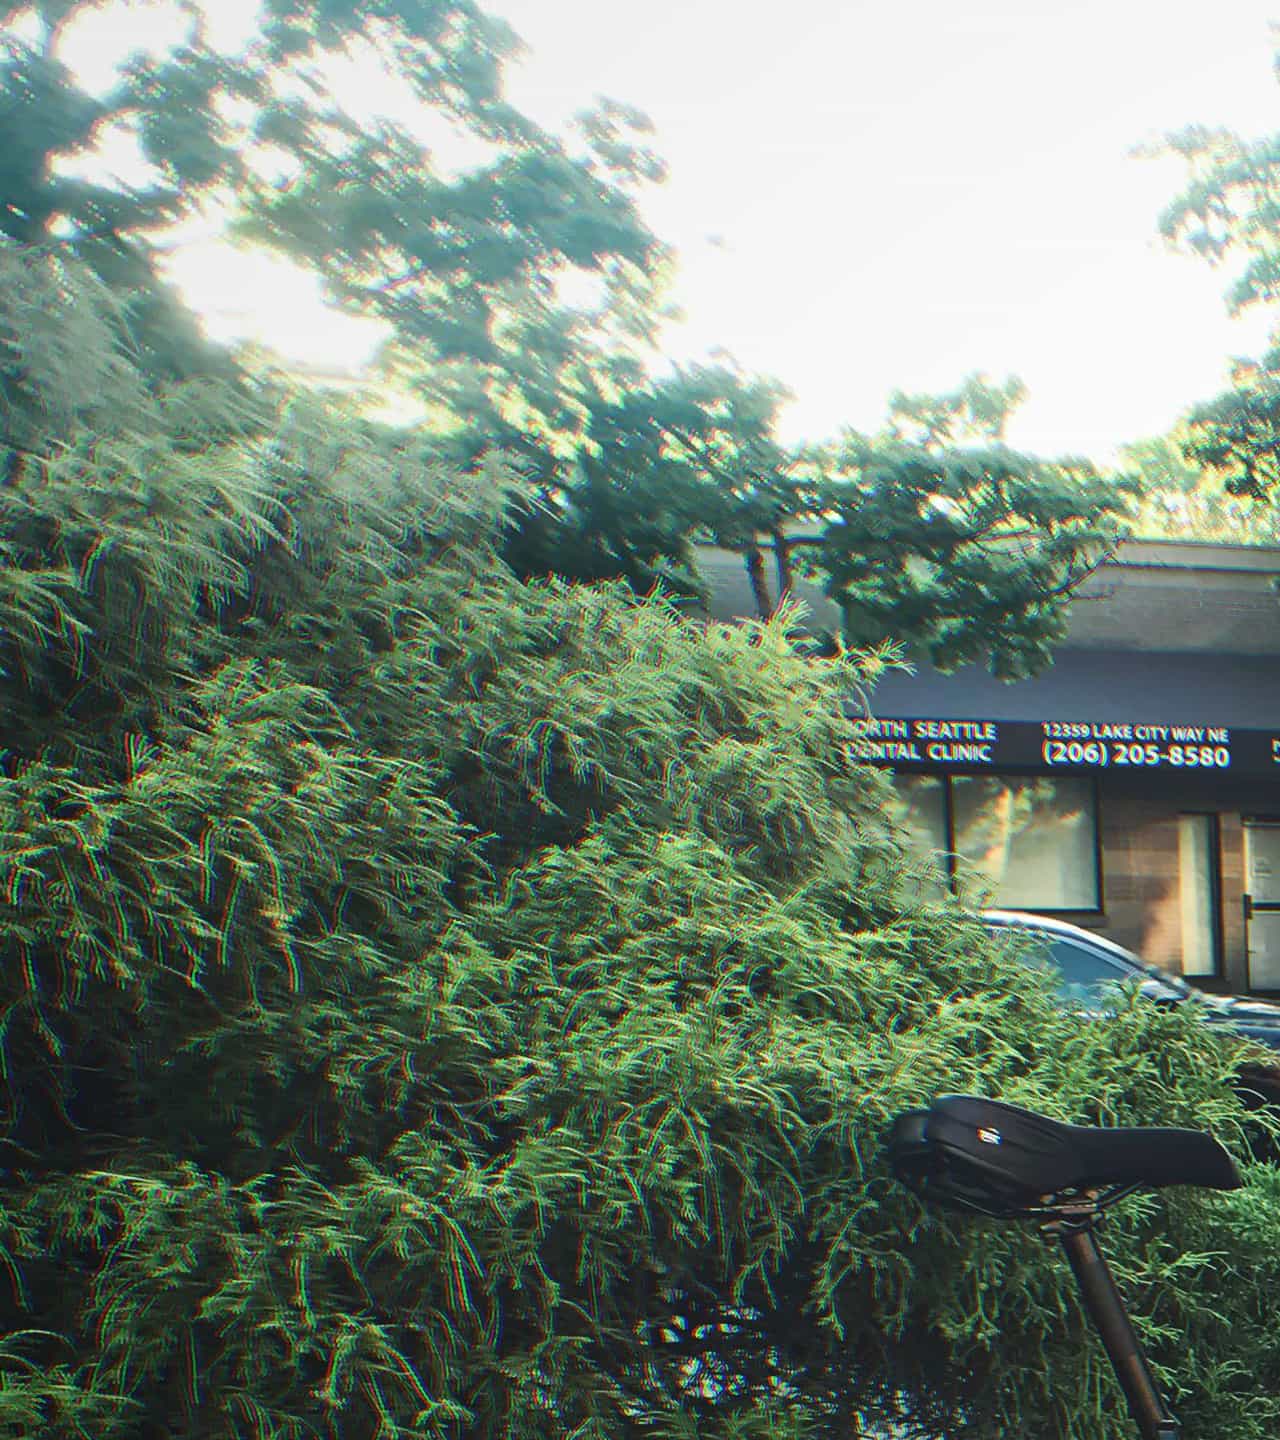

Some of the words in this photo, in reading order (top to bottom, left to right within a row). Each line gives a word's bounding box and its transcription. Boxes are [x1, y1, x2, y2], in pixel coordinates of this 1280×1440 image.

[848, 719, 909, 737] ORTH
[914, 720, 998, 740] SEATTLE
[1041, 721, 1090, 737] 12359
[1092, 723, 1134, 740] LAKE
[1134, 724, 1171, 742] CITY
[1171, 725, 1205, 742] WAY
[1206, 726, 1230, 744] NE
[926, 743, 993, 762] CLINIC
[1041, 739, 1109, 767] (206)
[1111, 741, 1231, 768] 205-8580
